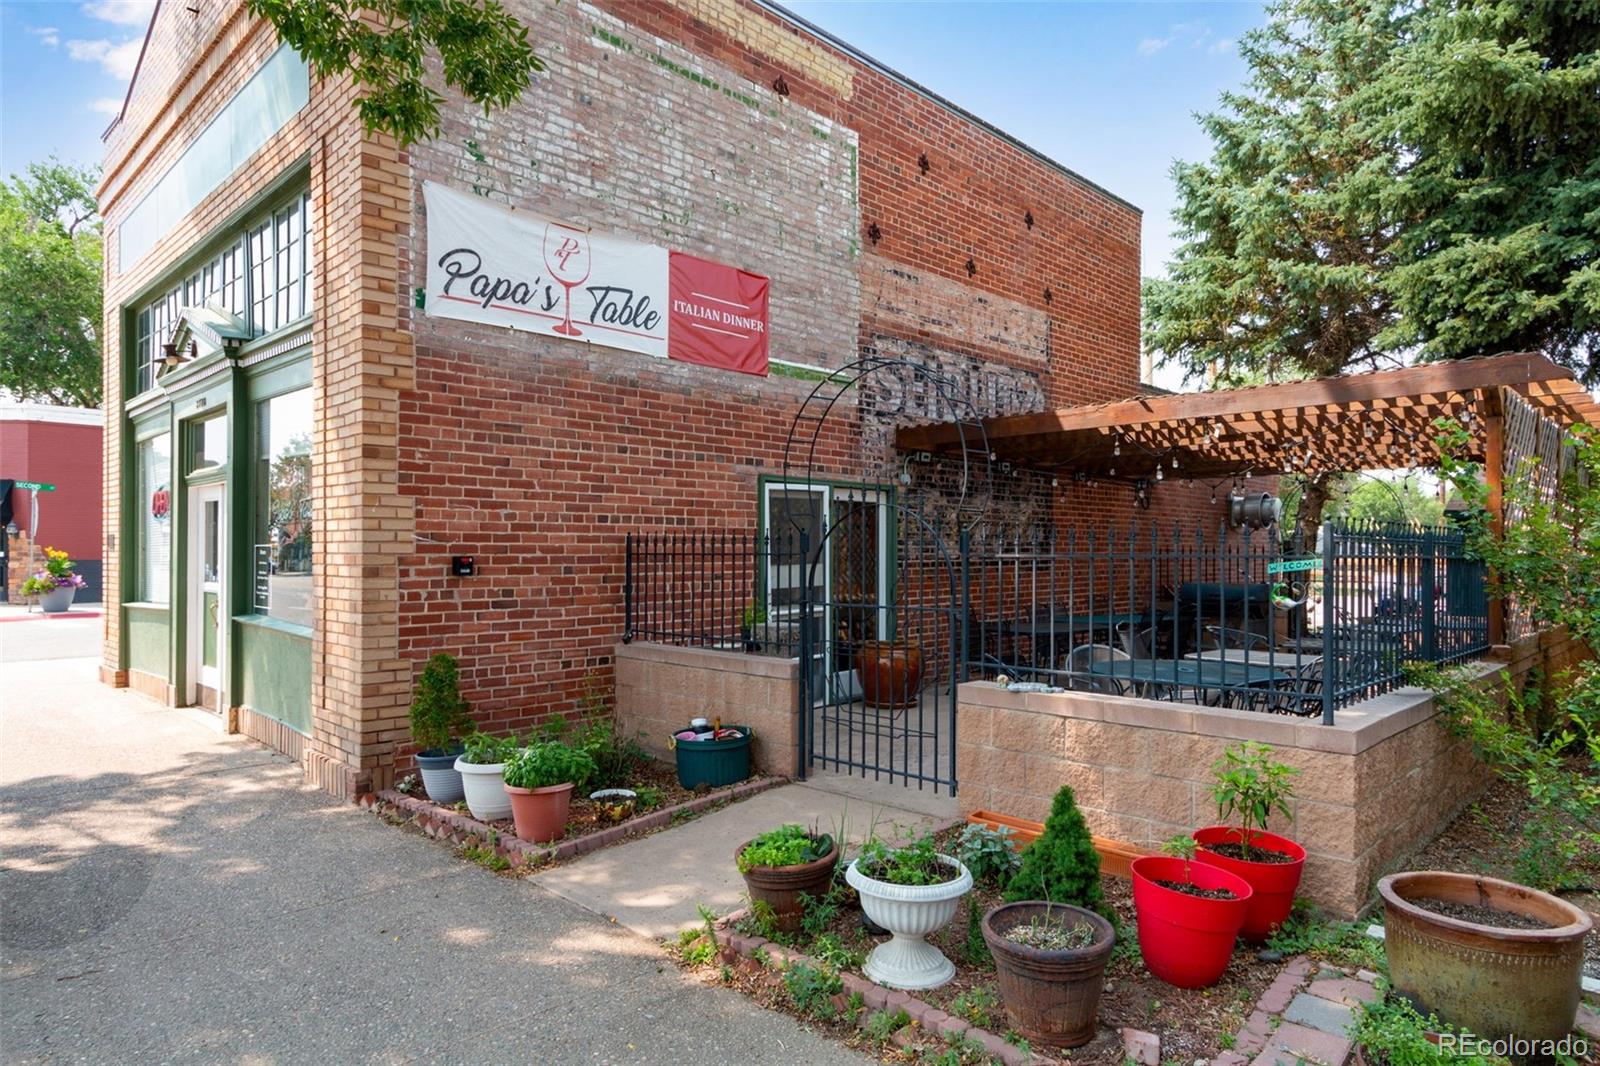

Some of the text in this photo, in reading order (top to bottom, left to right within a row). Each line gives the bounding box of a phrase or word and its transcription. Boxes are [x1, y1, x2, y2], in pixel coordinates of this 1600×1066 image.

[438, 248, 662, 331] Papa's Table
[673, 300, 764, 333] ITALIAN DINNER
[1269, 561, 1321, 571] WLCOM
